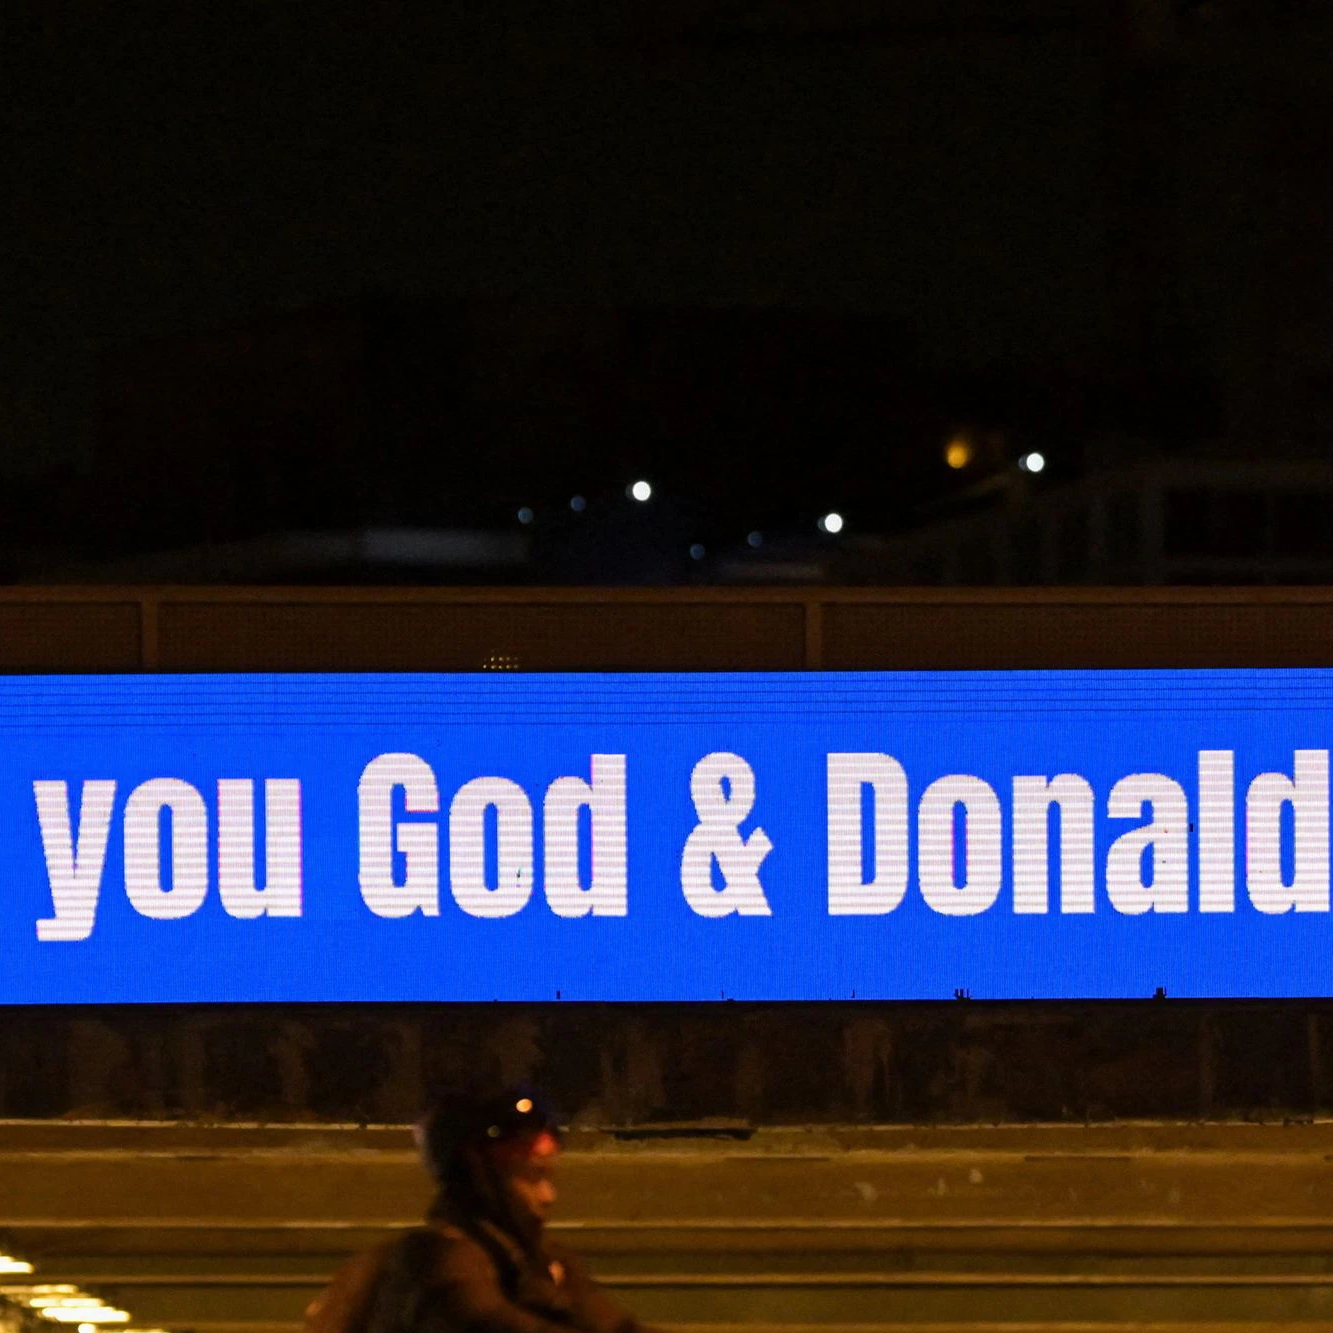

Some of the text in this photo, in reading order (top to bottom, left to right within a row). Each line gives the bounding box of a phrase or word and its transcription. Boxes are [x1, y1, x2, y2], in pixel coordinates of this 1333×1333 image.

[33, 777, 302, 941] you
[357, 752, 628, 918] God
[680, 751, 773, 917] &
[827, 749, 1330, 917] Donald
